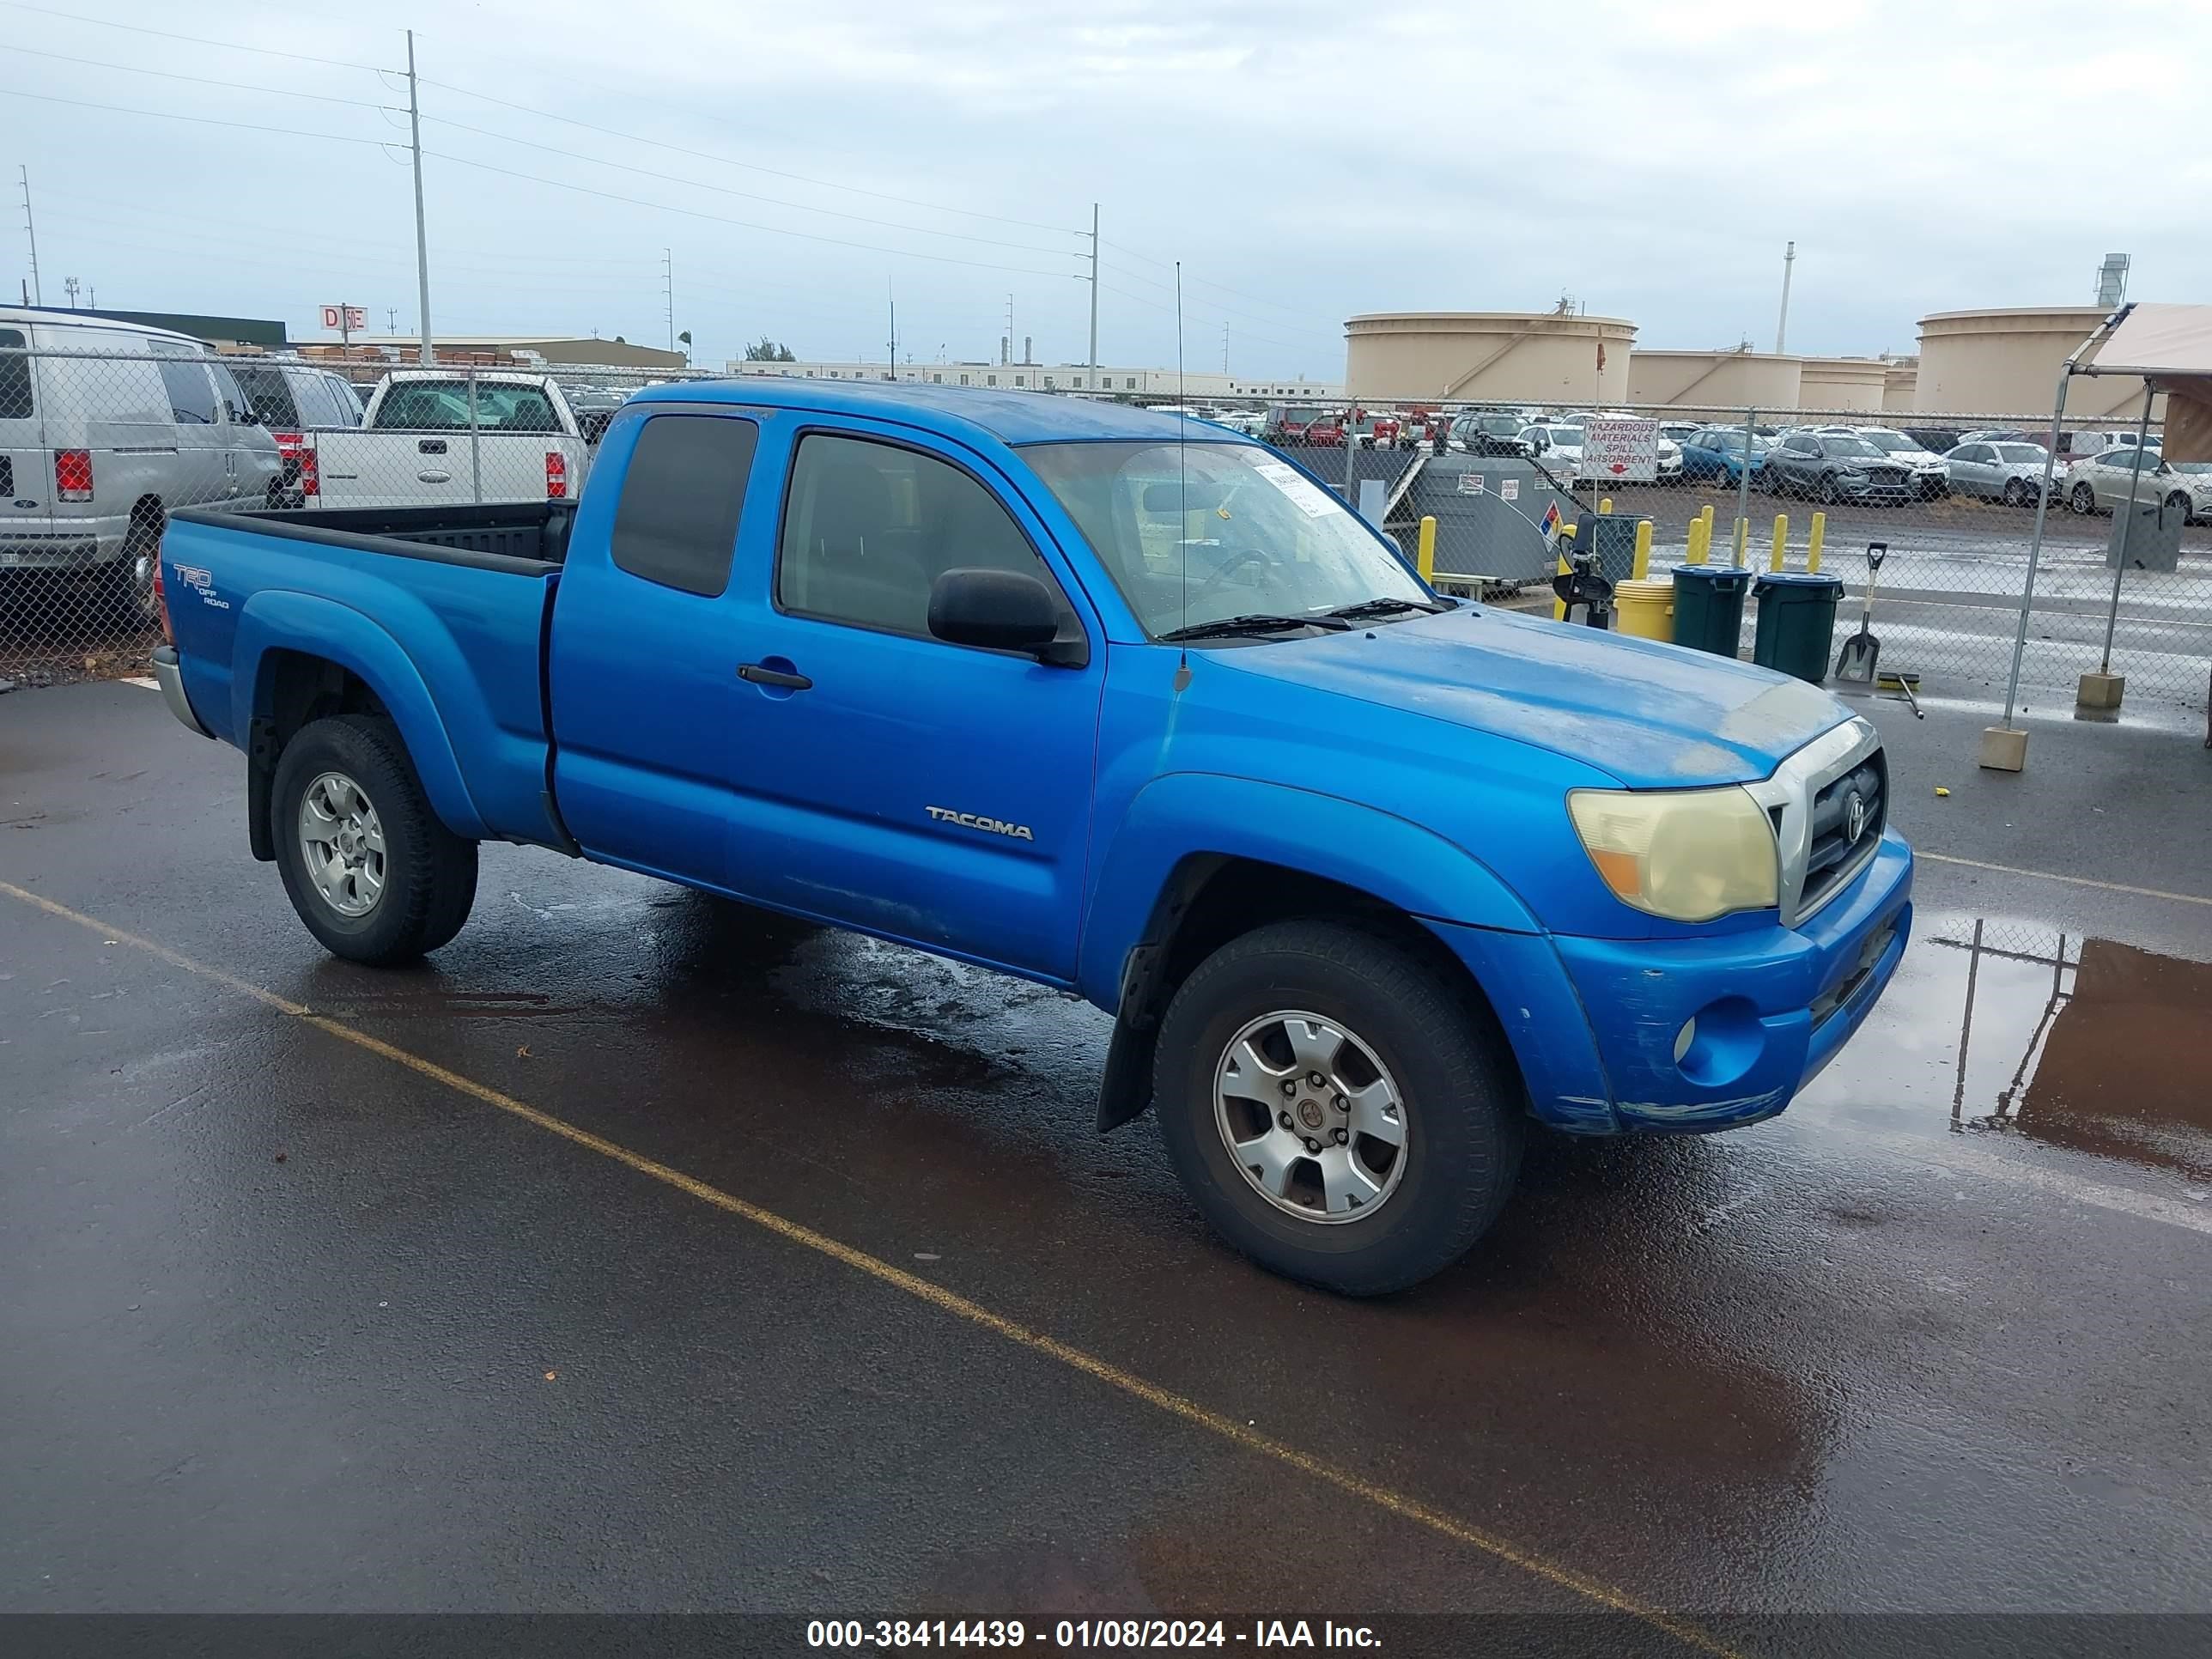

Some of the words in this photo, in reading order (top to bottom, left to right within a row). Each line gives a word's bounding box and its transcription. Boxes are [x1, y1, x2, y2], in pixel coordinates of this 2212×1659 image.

[1588, 422, 1656, 432] HAZARDOUS
[1591, 434, 1651, 442] MATERIALS
[1605, 444, 1635, 453] SPILL
[1585, 454, 1654, 464] ABSORBENT
[173, 563, 212, 590] TRD
[198, 587, 217, 598] OFF
[204, 597, 229, 609] ROAD
[925, 805, 1034, 841] TACOMA
